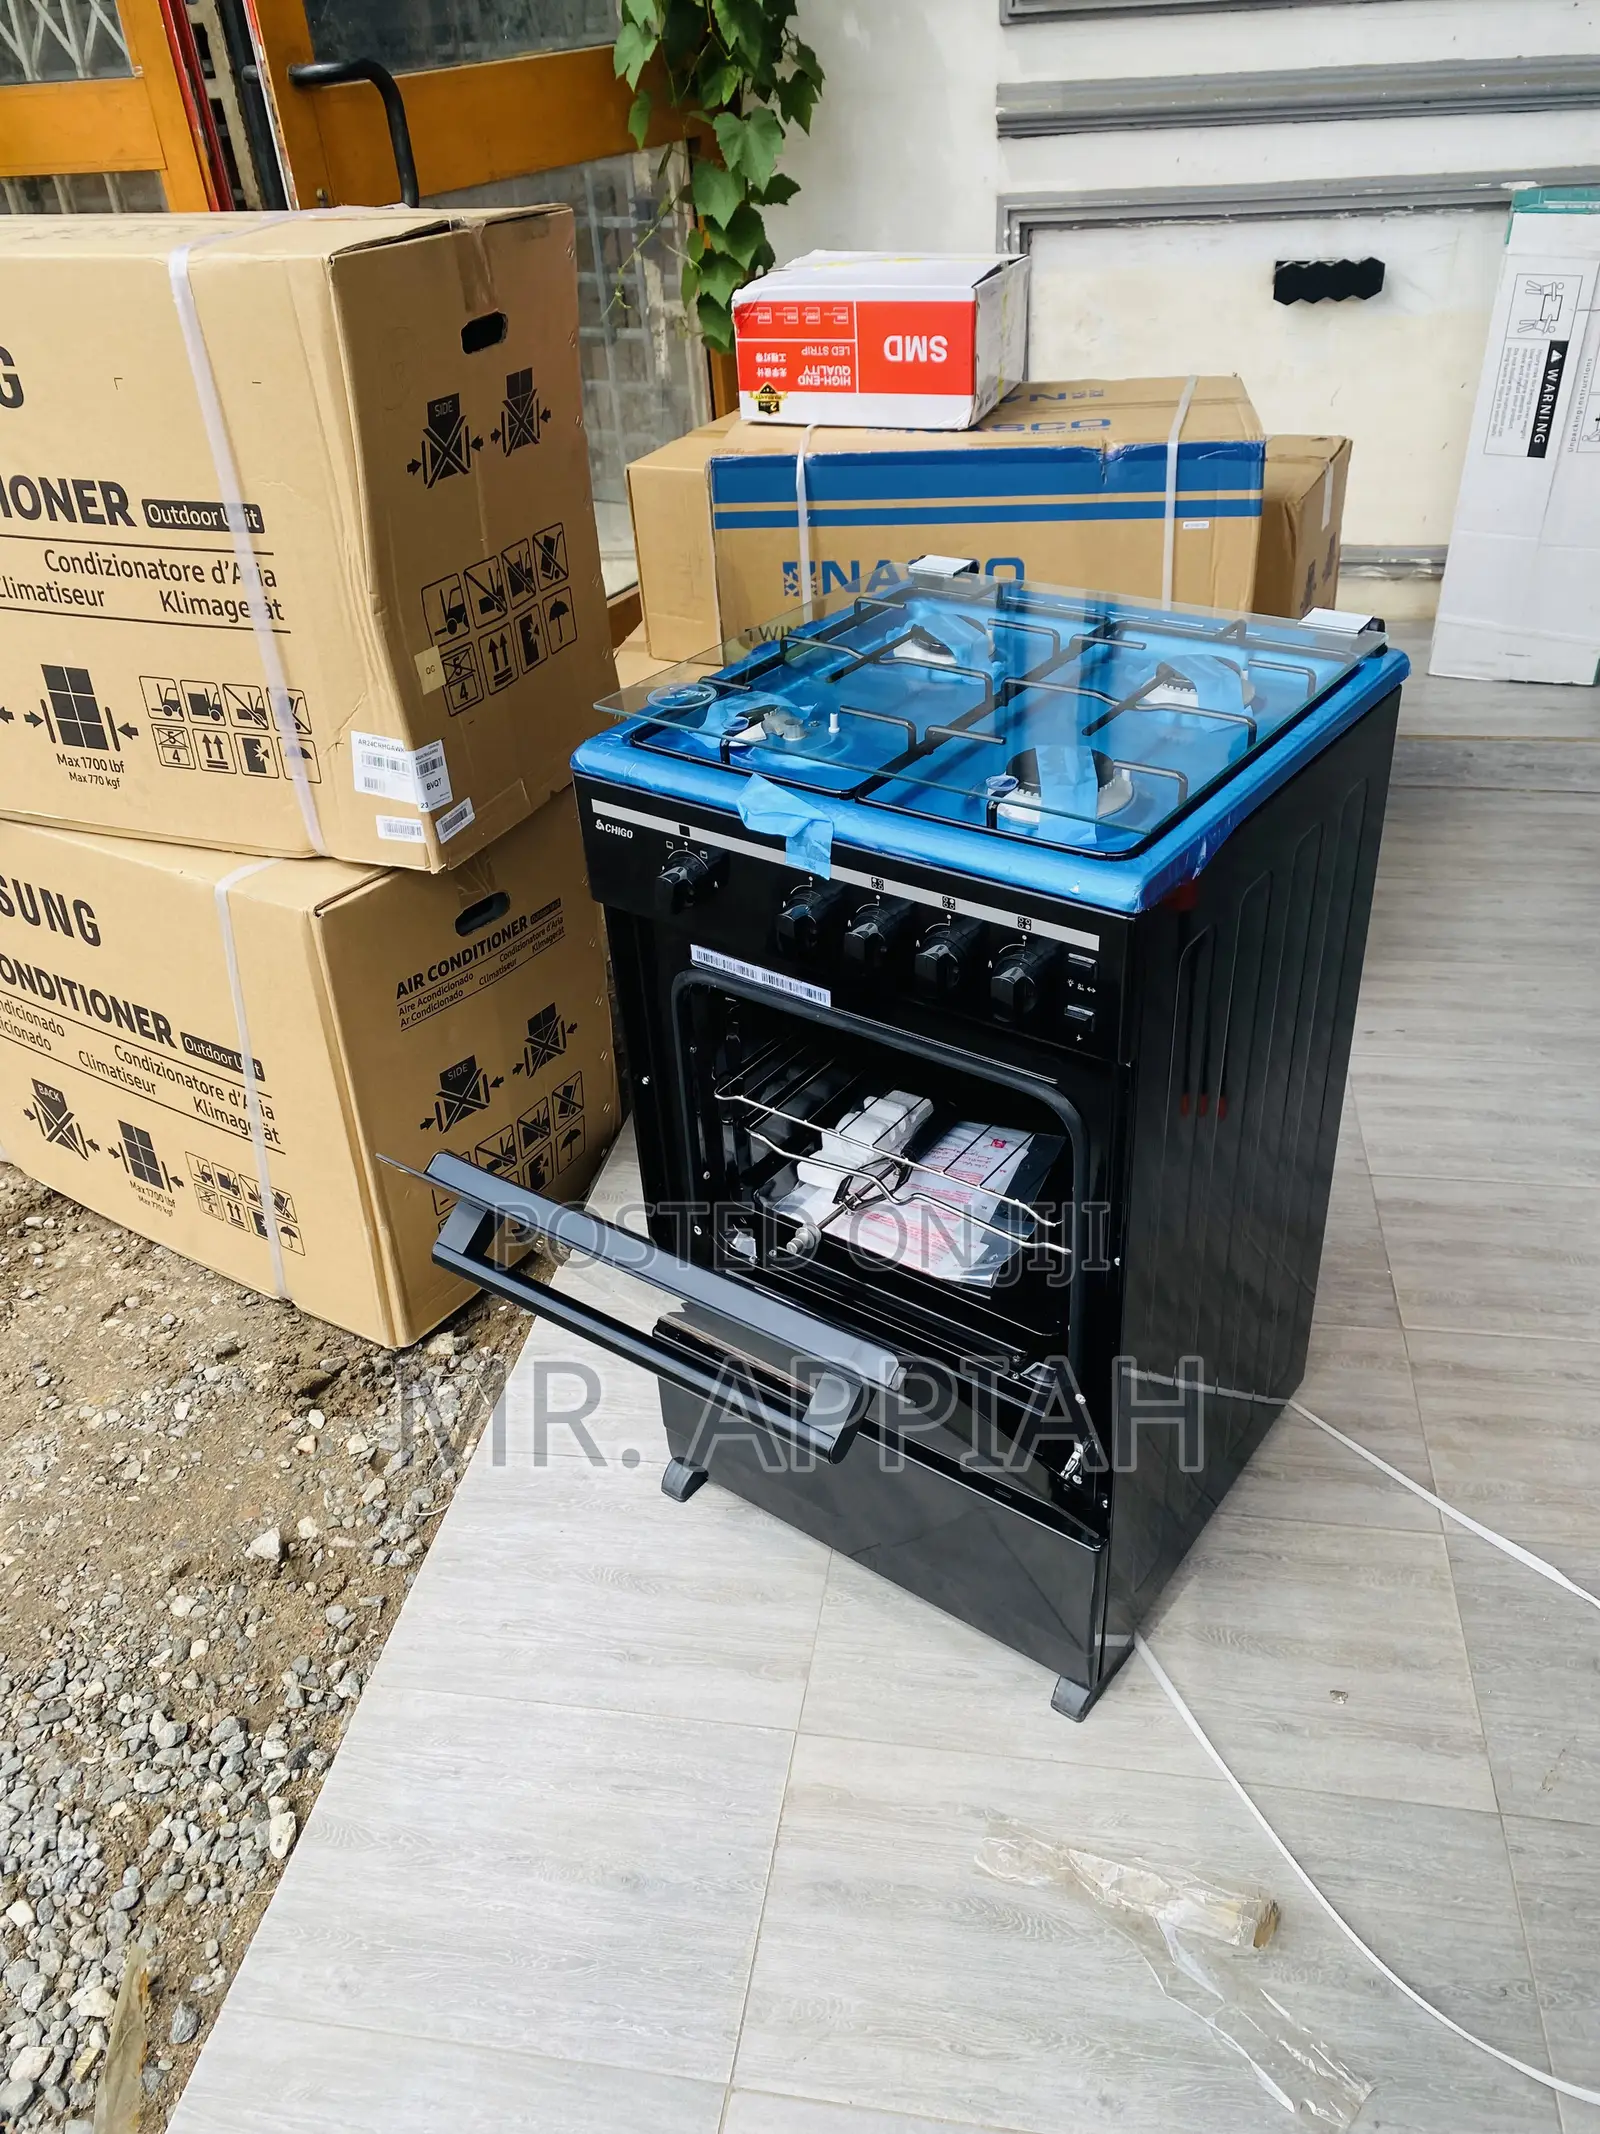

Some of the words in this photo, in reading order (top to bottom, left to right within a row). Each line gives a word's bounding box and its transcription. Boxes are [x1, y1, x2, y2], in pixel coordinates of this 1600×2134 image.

[801, 345, 829, 356] STRIP
[831, 345, 851, 357] LED
[883, 334, 949, 363] SMD
[797, 374, 851, 387] HIGH-END
[802, 364, 851, 376] QUALITY
[434, 400, 453, 417] SIDE
[1533, 369, 1559, 444] WARNING
[149, 503, 217, 526] Outdoor
[44, 549, 205, 583] Condizionatore
[458, 682, 468, 700] 4
[57, 753, 81, 769] Max
[81, 757, 107, 772] 1700
[110, 759, 124, 775] lbf
[172, 750, 181, 762] 4
[69, 771, 88, 785] Max
[88, 774, 105, 786] 770
[106, 777, 120, 790] kgf
[605, 823, 634, 839] CHIGO
[500, 929, 546, 962] Condizionatore
[546, 916, 564, 932] d'Aria
[396, 972, 425, 1000] AIR
[427, 915, 528, 982] CONDITIONER
[478, 958, 517, 986] Climatiseur
[398, 1002, 415, 1017] Aire
[417, 972, 474, 1008] Acondicionado
[400, 1017, 410, 1028] Ar
[411, 989, 463, 1021] Condicionado
[184, 1036, 233, 1064] Outdoor
[78, 1050, 157, 1095] Climatiseur
[114, 1044, 225, 1101] Condizionatore
[447, 1063, 469, 1081] SIDE
[37, 1083, 62, 1103] BACK
[129, 1180, 145, 1196] Max
[145, 1188, 165, 1204] 1700
